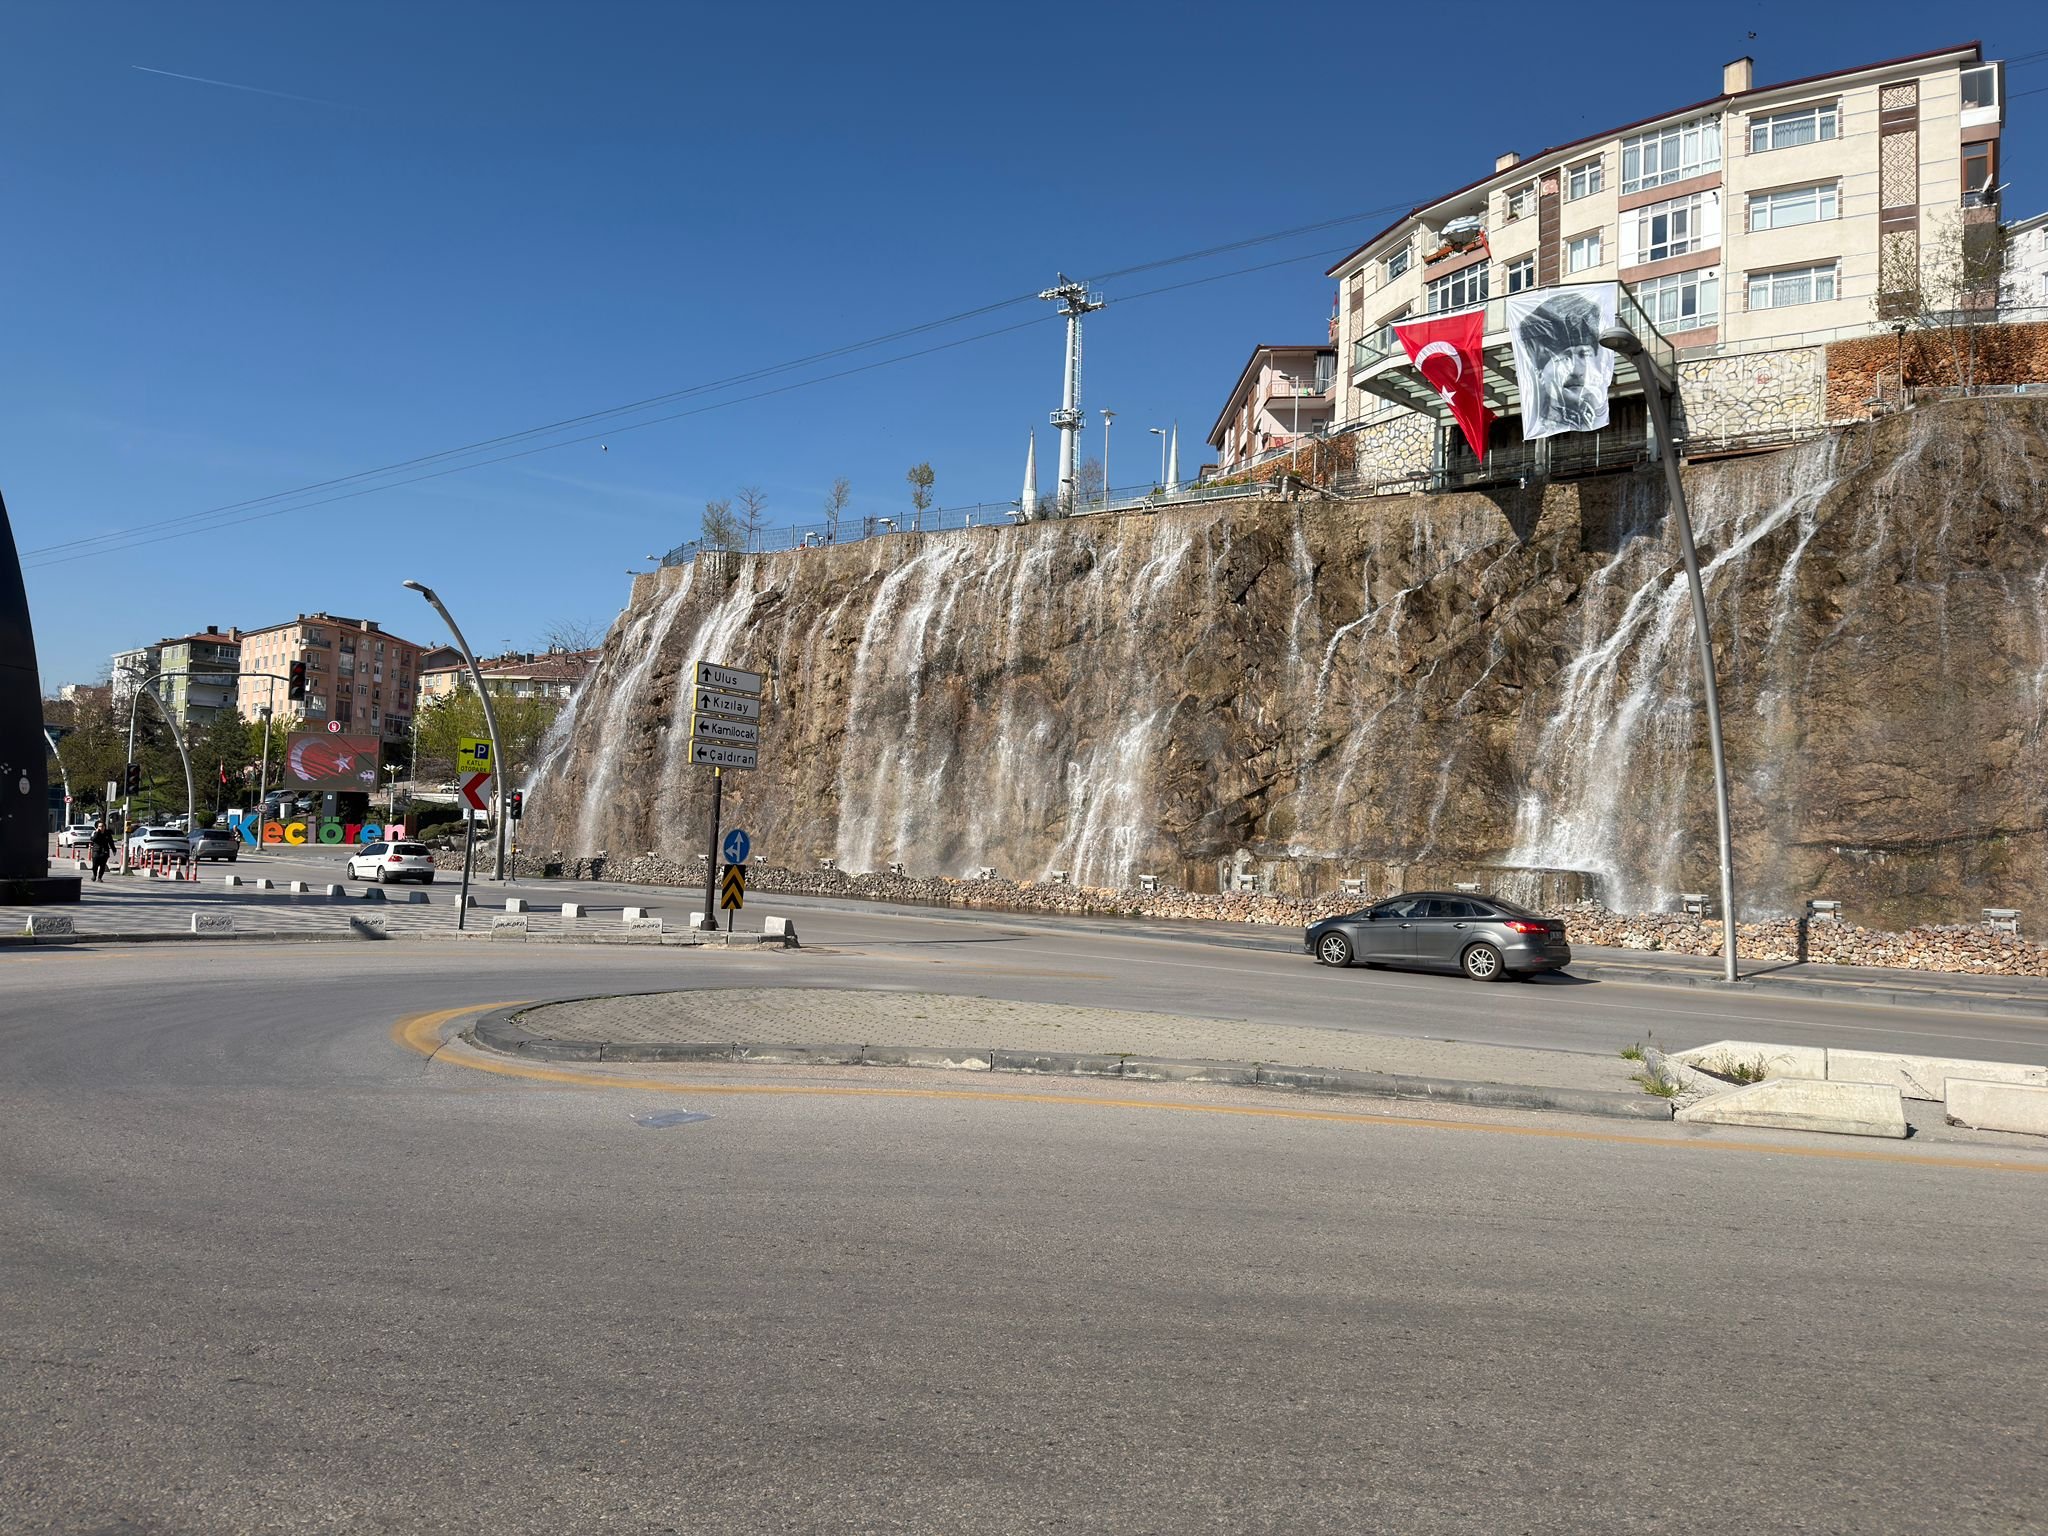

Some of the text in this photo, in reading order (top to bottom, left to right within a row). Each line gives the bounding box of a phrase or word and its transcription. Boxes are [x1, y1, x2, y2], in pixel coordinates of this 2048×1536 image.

[714, 672, 737, 685] Ulus
[713, 697, 749, 714] Kızılay
[711, 723, 755, 739] Kamilocak
[709, 749, 754, 764] Çaldıran
[229, 814, 406, 846] Keçiören
